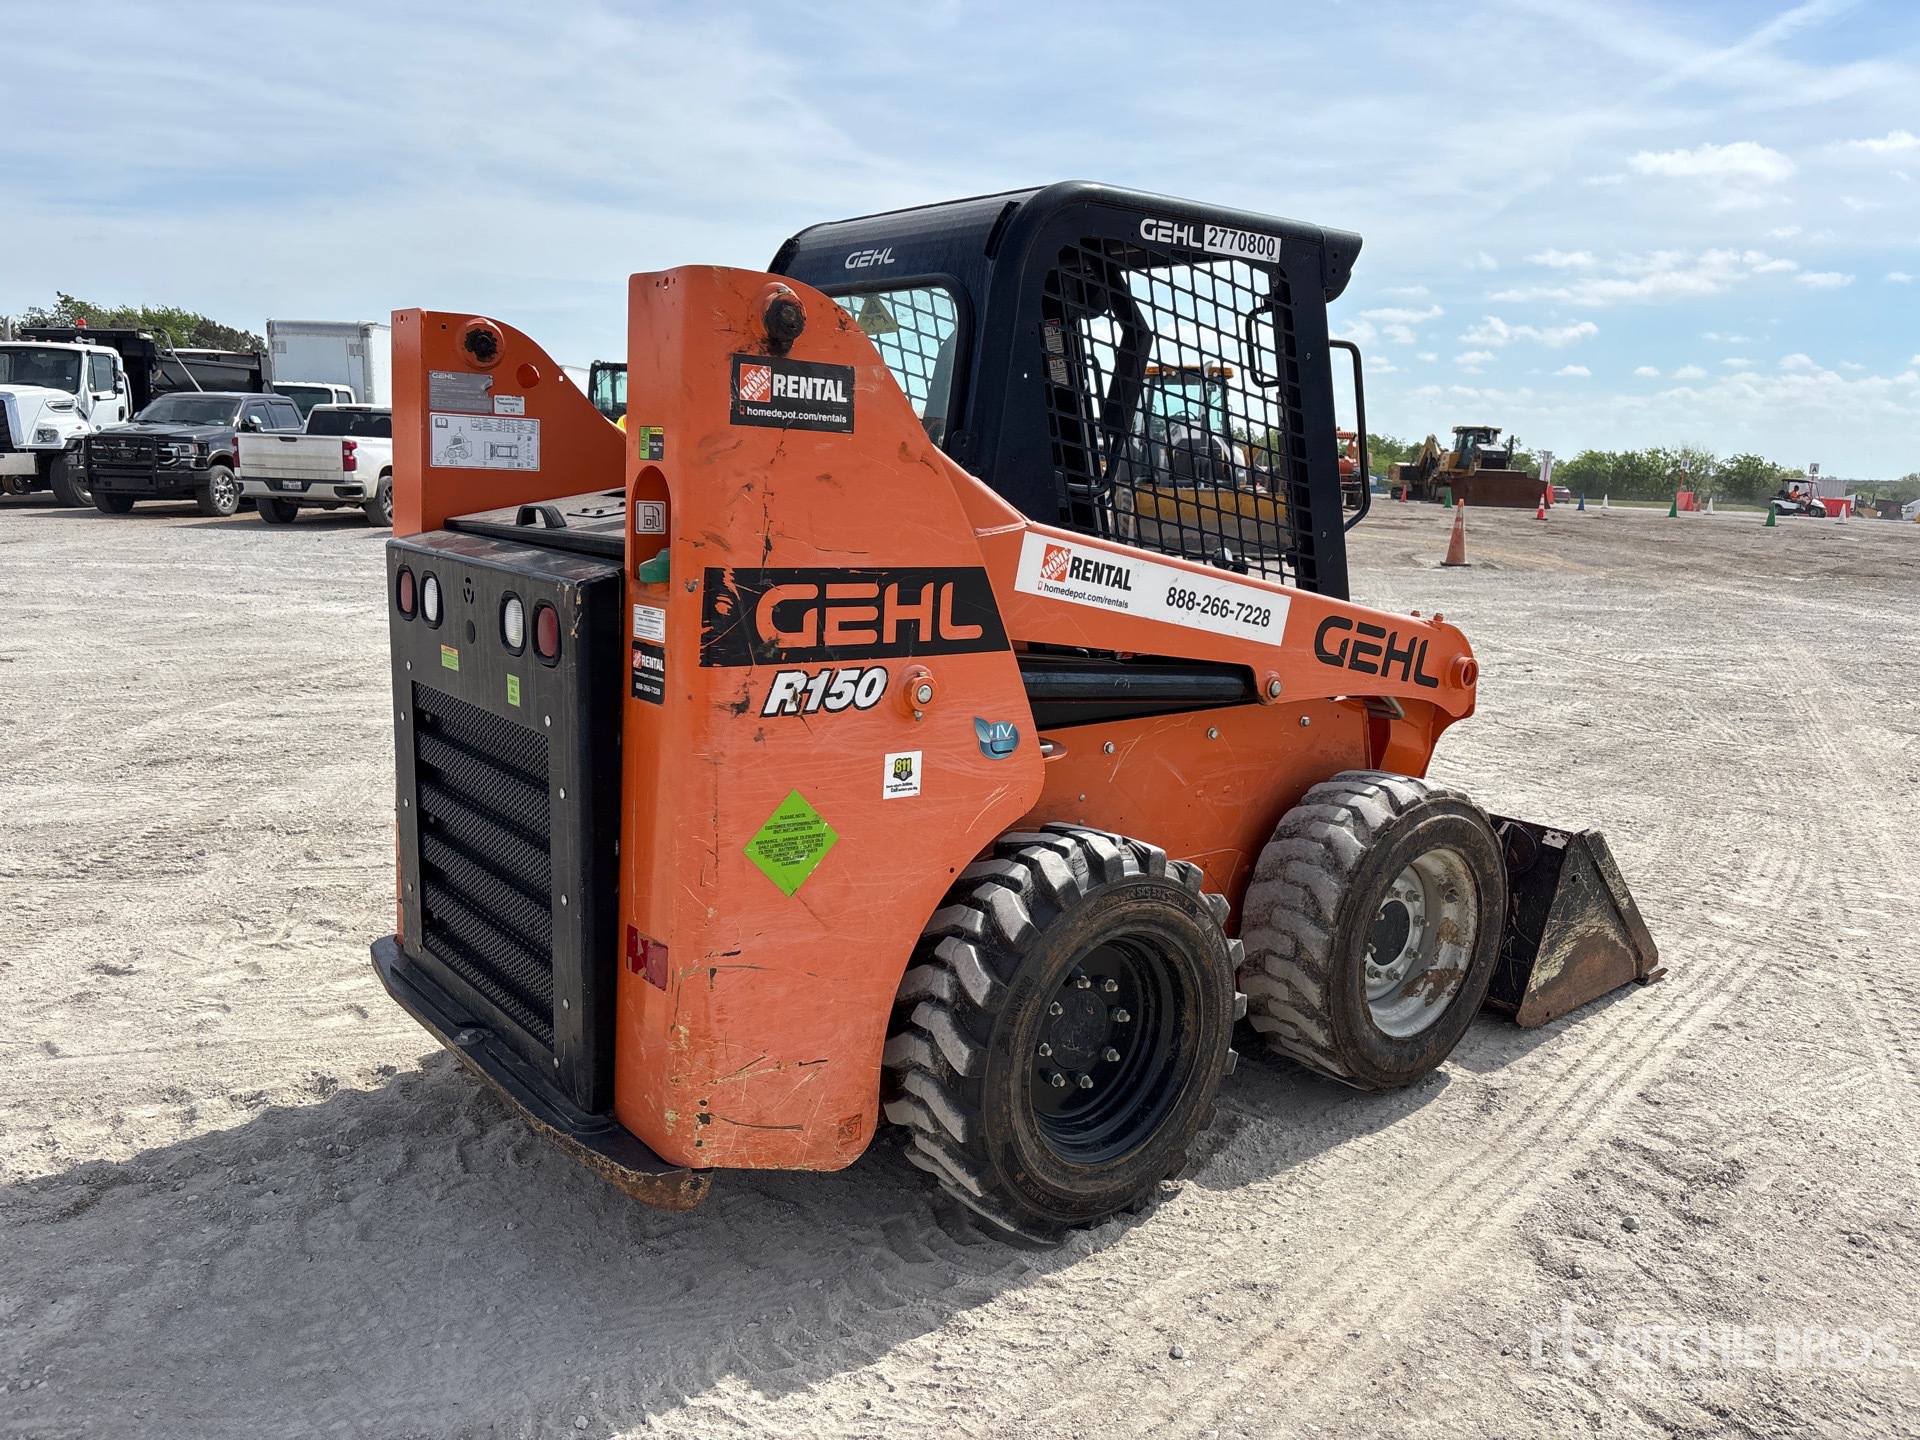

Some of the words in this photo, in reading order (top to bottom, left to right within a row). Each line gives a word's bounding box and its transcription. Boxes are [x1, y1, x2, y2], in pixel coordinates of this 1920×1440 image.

[1140, 218, 1202, 248] GEHL
[1208, 226, 1276, 257] 2770800
[844, 246, 896, 270] GEHL
[432, 372, 456, 380] GEHL
[740, 366, 770, 400] HOME
[743, 368, 758, 382] THE
[773, 374, 848, 402] RENTAL
[751, 380, 770, 400] DEPOT
[746, 406, 847, 424] homedepot.com/rentals
[1041, 548, 1071, 579] HOME
[1046, 548, 1058, 562] THE
[1050, 560, 1068, 580] DEPOT
[1068, 556, 1132, 591] RENTAL
[1044, 582, 1129, 609] homedepot.com/rentals
[1166, 586, 1271, 628] 888-266-7228
[755, 582, 983, 649] GEHL
[642, 654, 664, 672] RENTAL
[1314, 615, 1439, 688] GEHL
[761, 666, 888, 716] R150
[895, 758, 911, 773] 811
